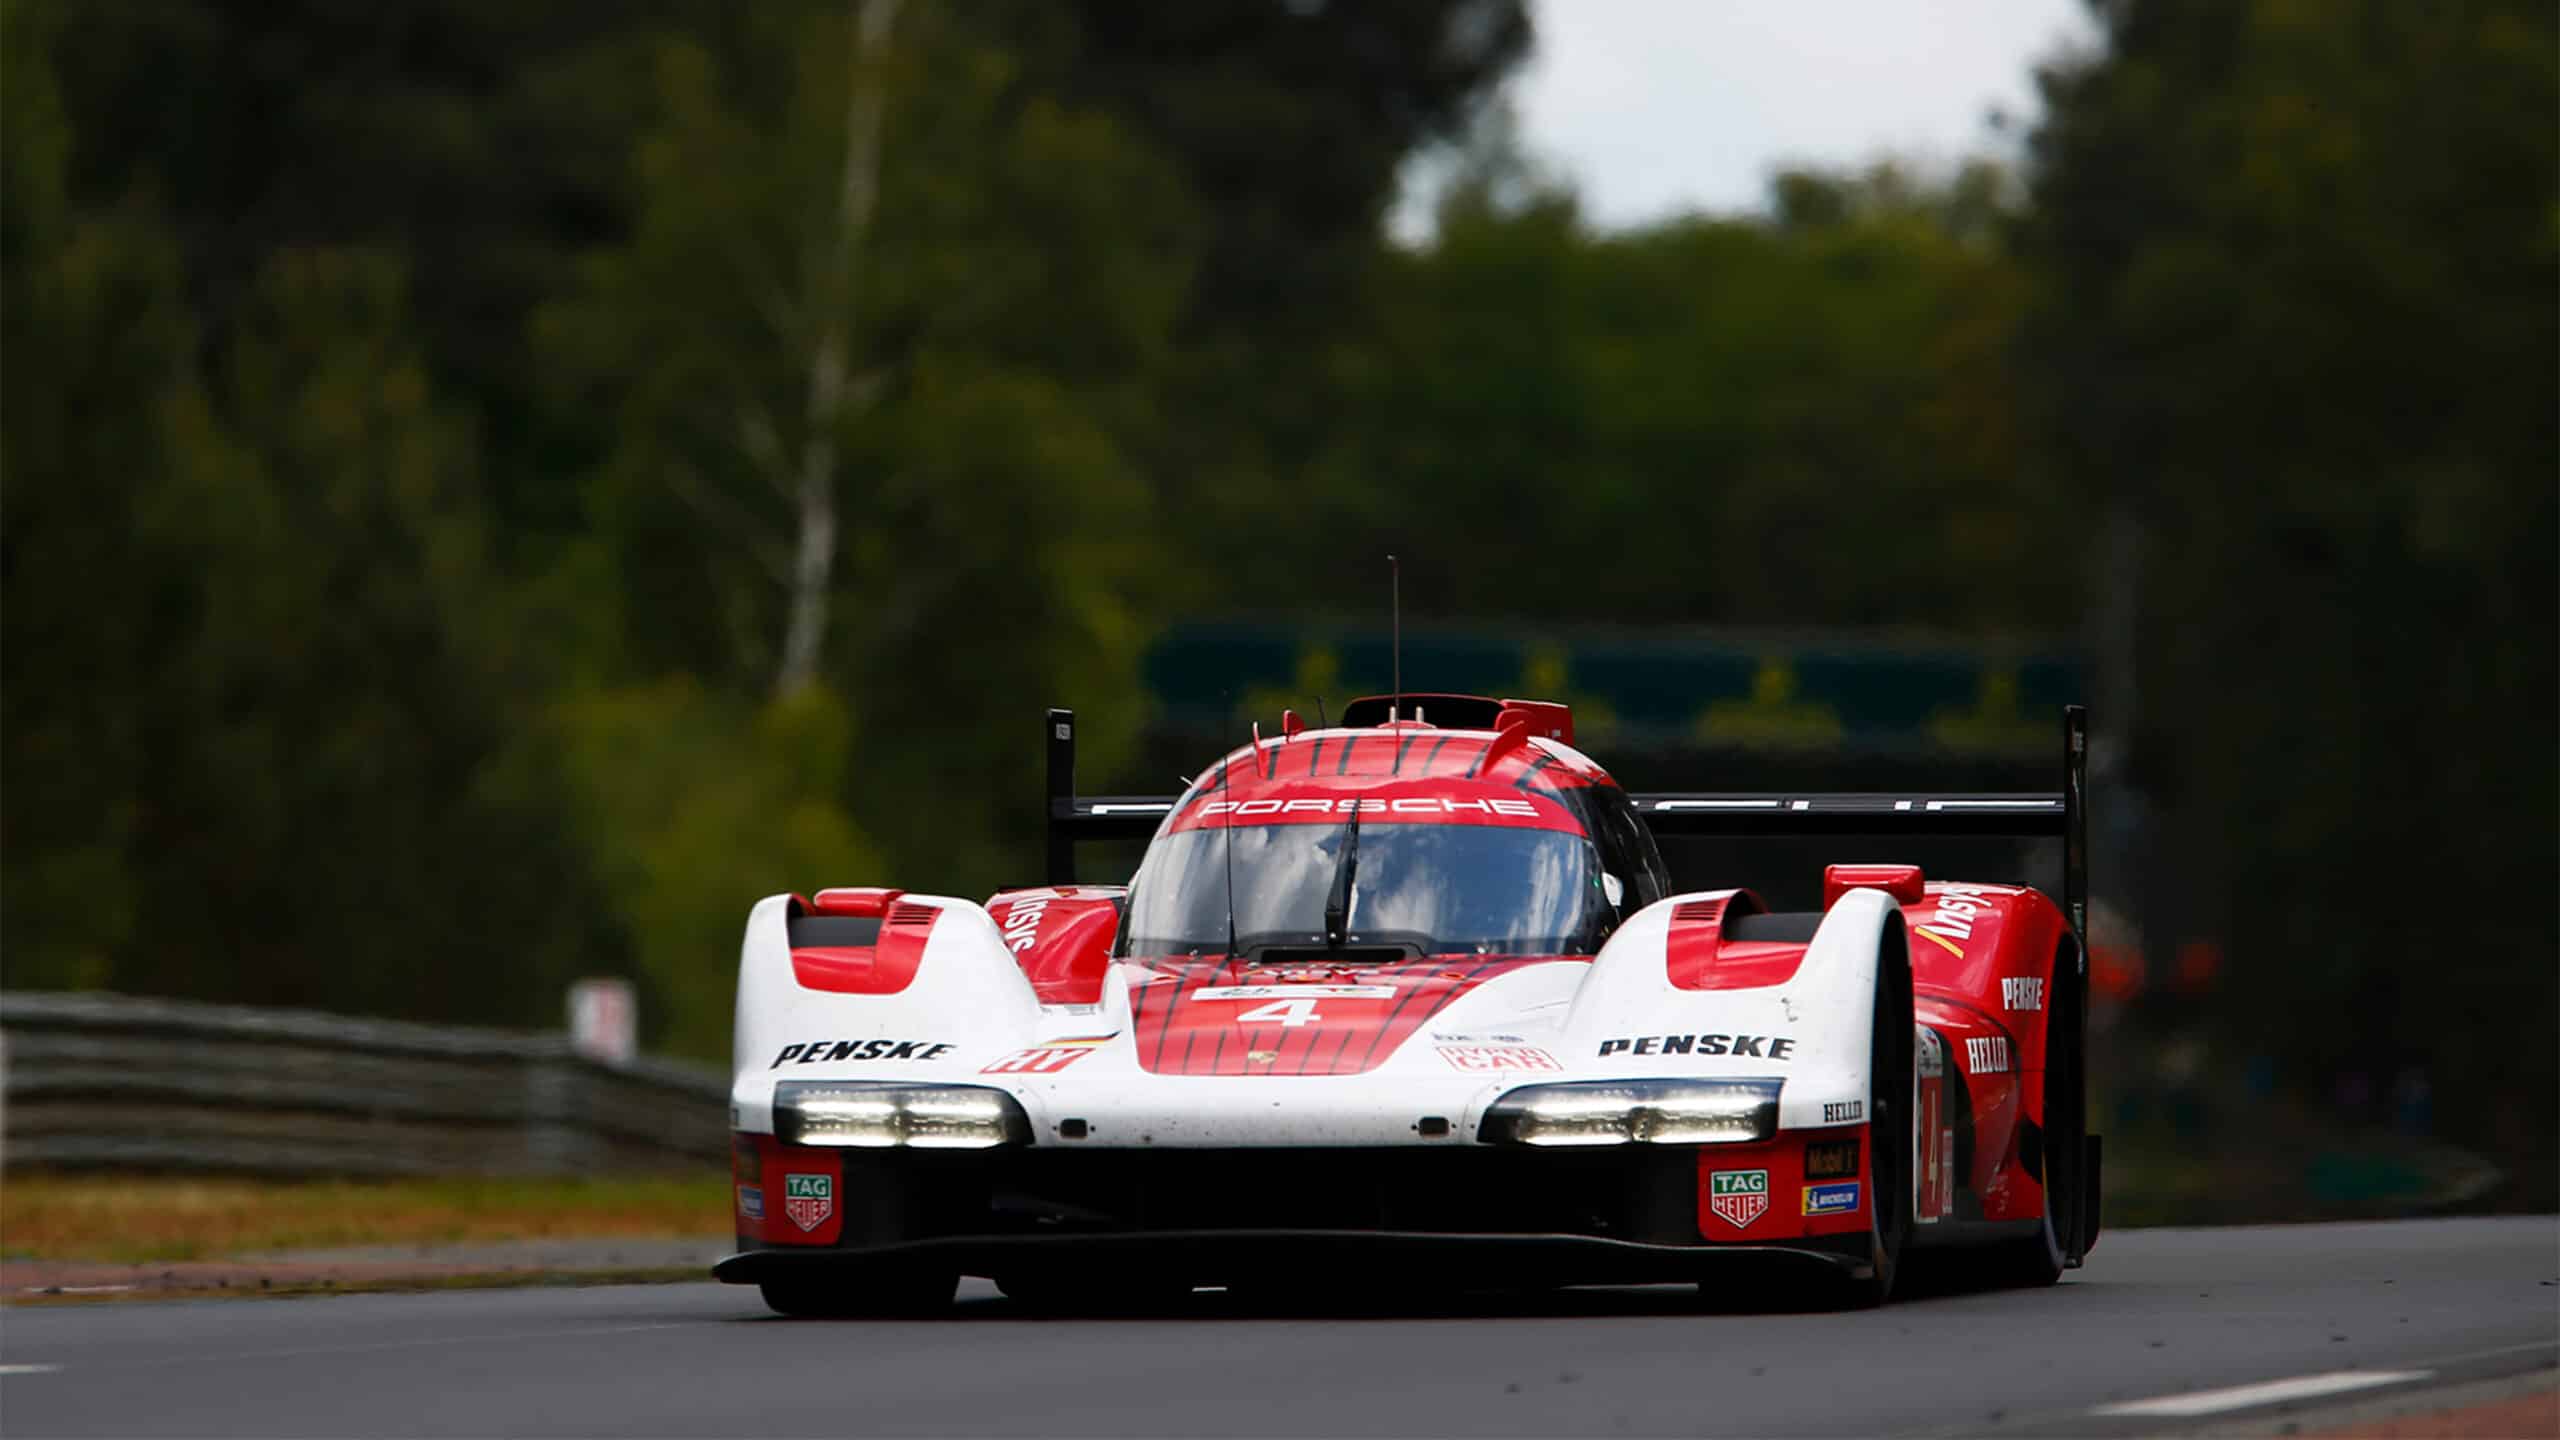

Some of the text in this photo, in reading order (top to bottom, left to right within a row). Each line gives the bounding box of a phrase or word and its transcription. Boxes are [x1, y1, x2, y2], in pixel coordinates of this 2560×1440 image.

[1197, 799, 1540, 818] PORSCHE
[2001, 977, 2043, 1010] PENSKE
[1237, 999, 1321, 1027] 4
[769, 1040, 957, 1070] PENSKE
[1445, 1046, 1540, 1056] HYPER
[1598, 1034, 1796, 1060] PENSKE
[1456, 1055, 1552, 1069] CAR
[789, 1179, 827, 1196] TAG
[1716, 1174, 1763, 1192] TAG
[1716, 1196, 1765, 1222] HEUER
